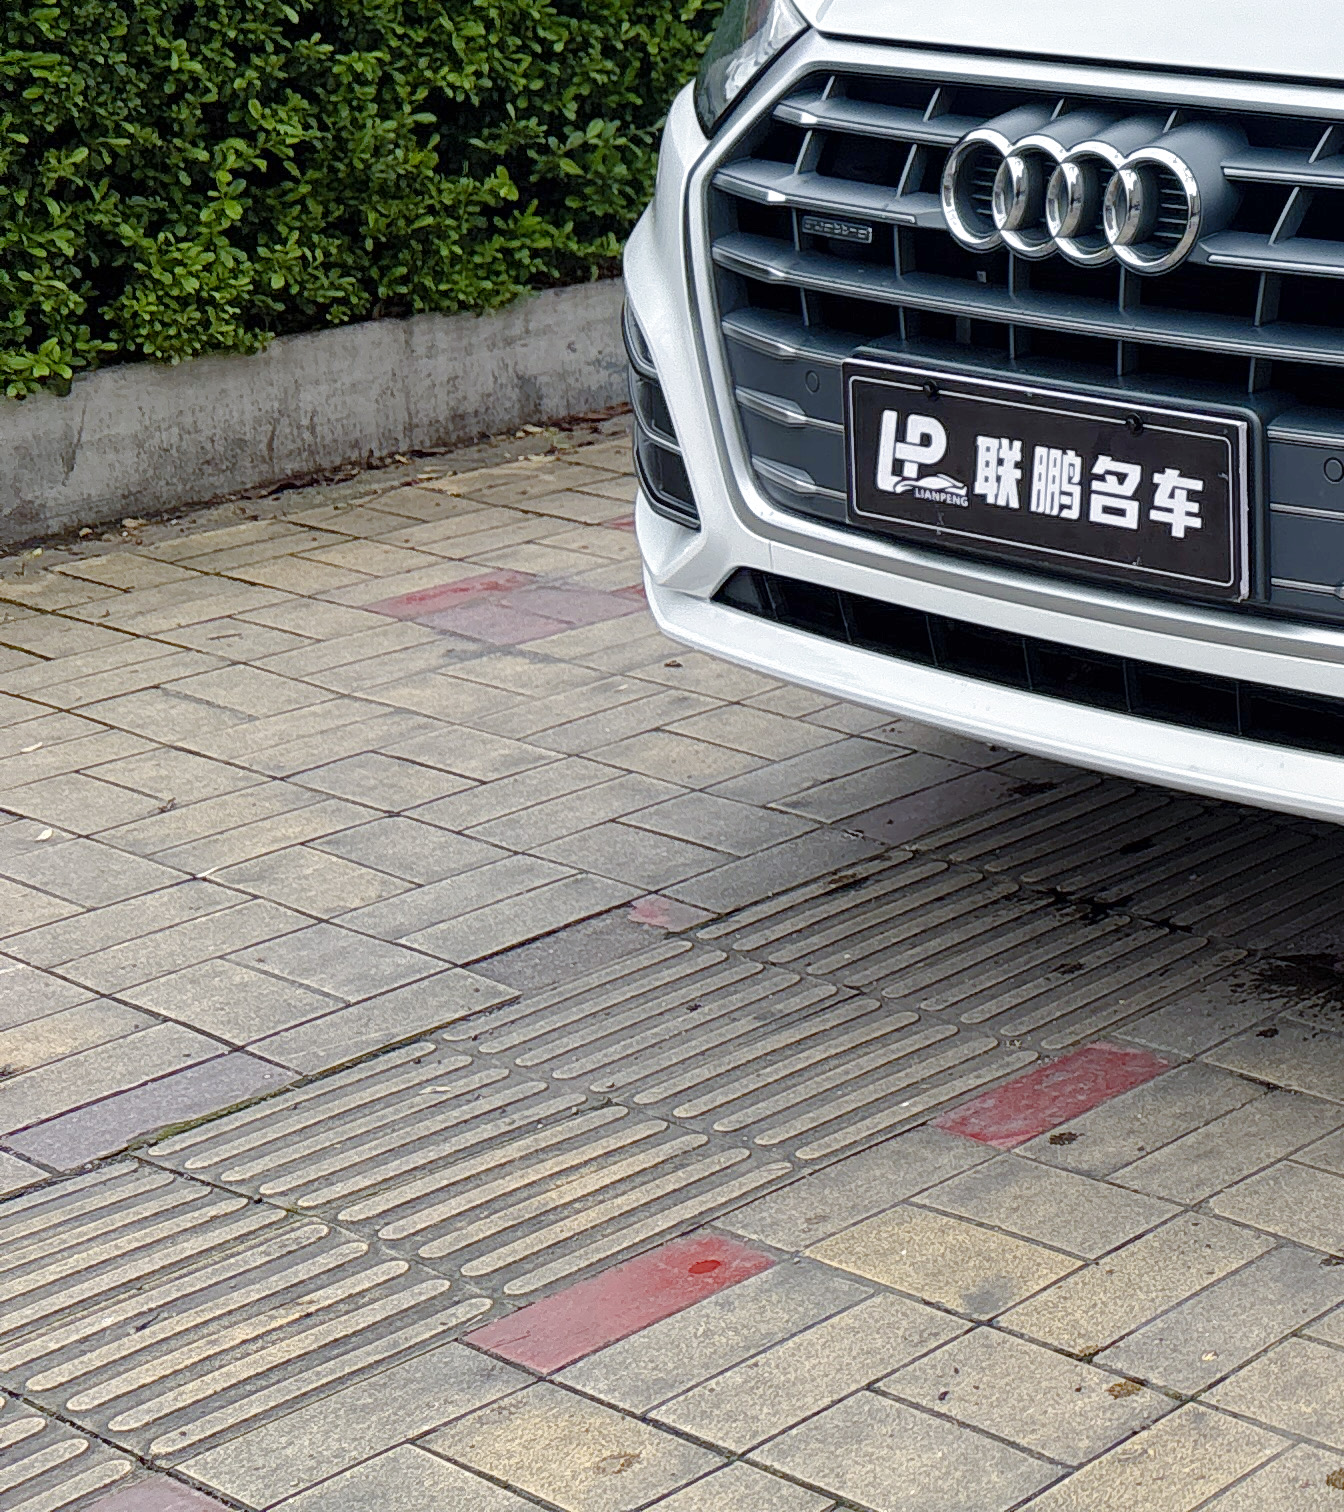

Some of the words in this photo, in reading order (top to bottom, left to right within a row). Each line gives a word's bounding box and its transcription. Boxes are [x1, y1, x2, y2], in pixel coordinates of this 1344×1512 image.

[914, 487, 969, 508] LIANPENG
[973, 435, 1204, 538] 联鹏名车
